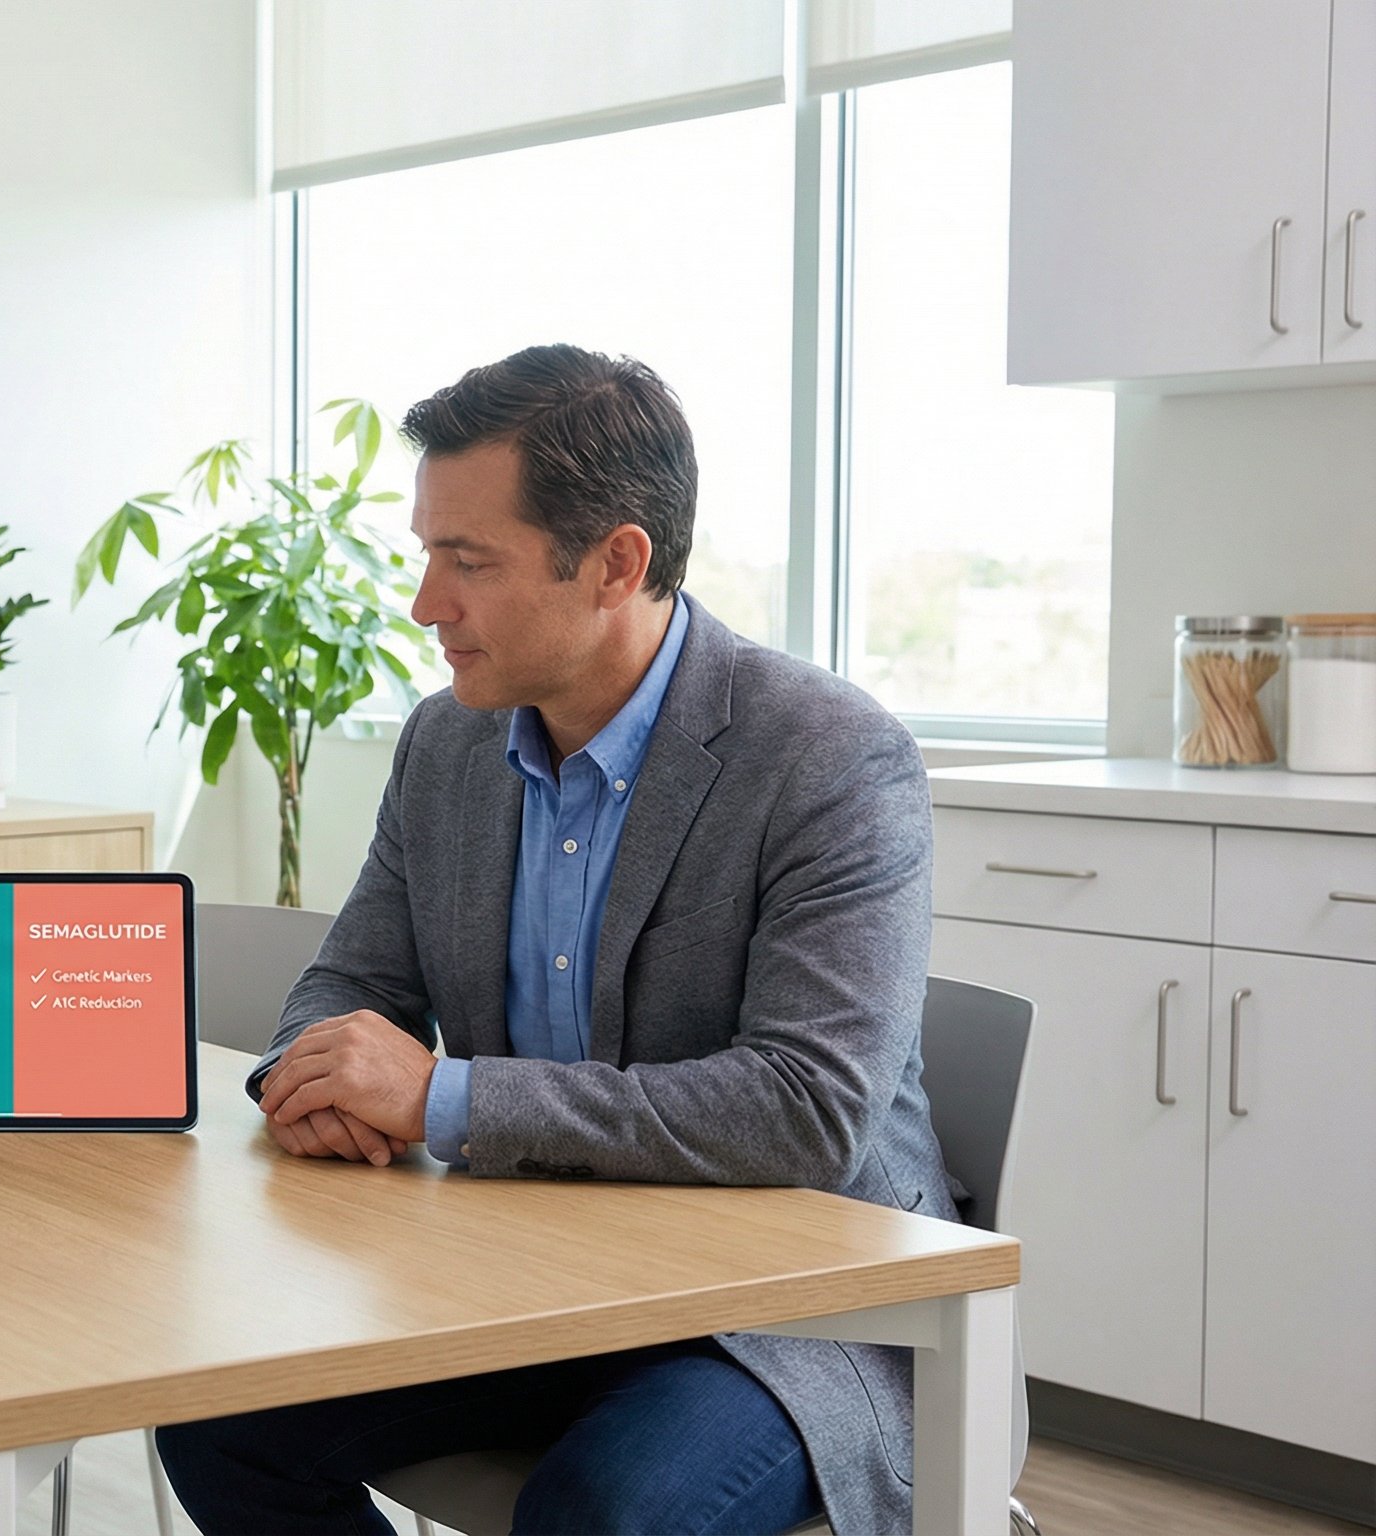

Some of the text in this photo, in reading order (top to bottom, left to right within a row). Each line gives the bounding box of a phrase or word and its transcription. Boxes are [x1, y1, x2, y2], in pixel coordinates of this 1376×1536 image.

[29, 924, 166, 939] SEMAGLUTIDE
[52, 969, 152, 982] Genetic Markers
[79, 995, 142, 1008] Reduction
